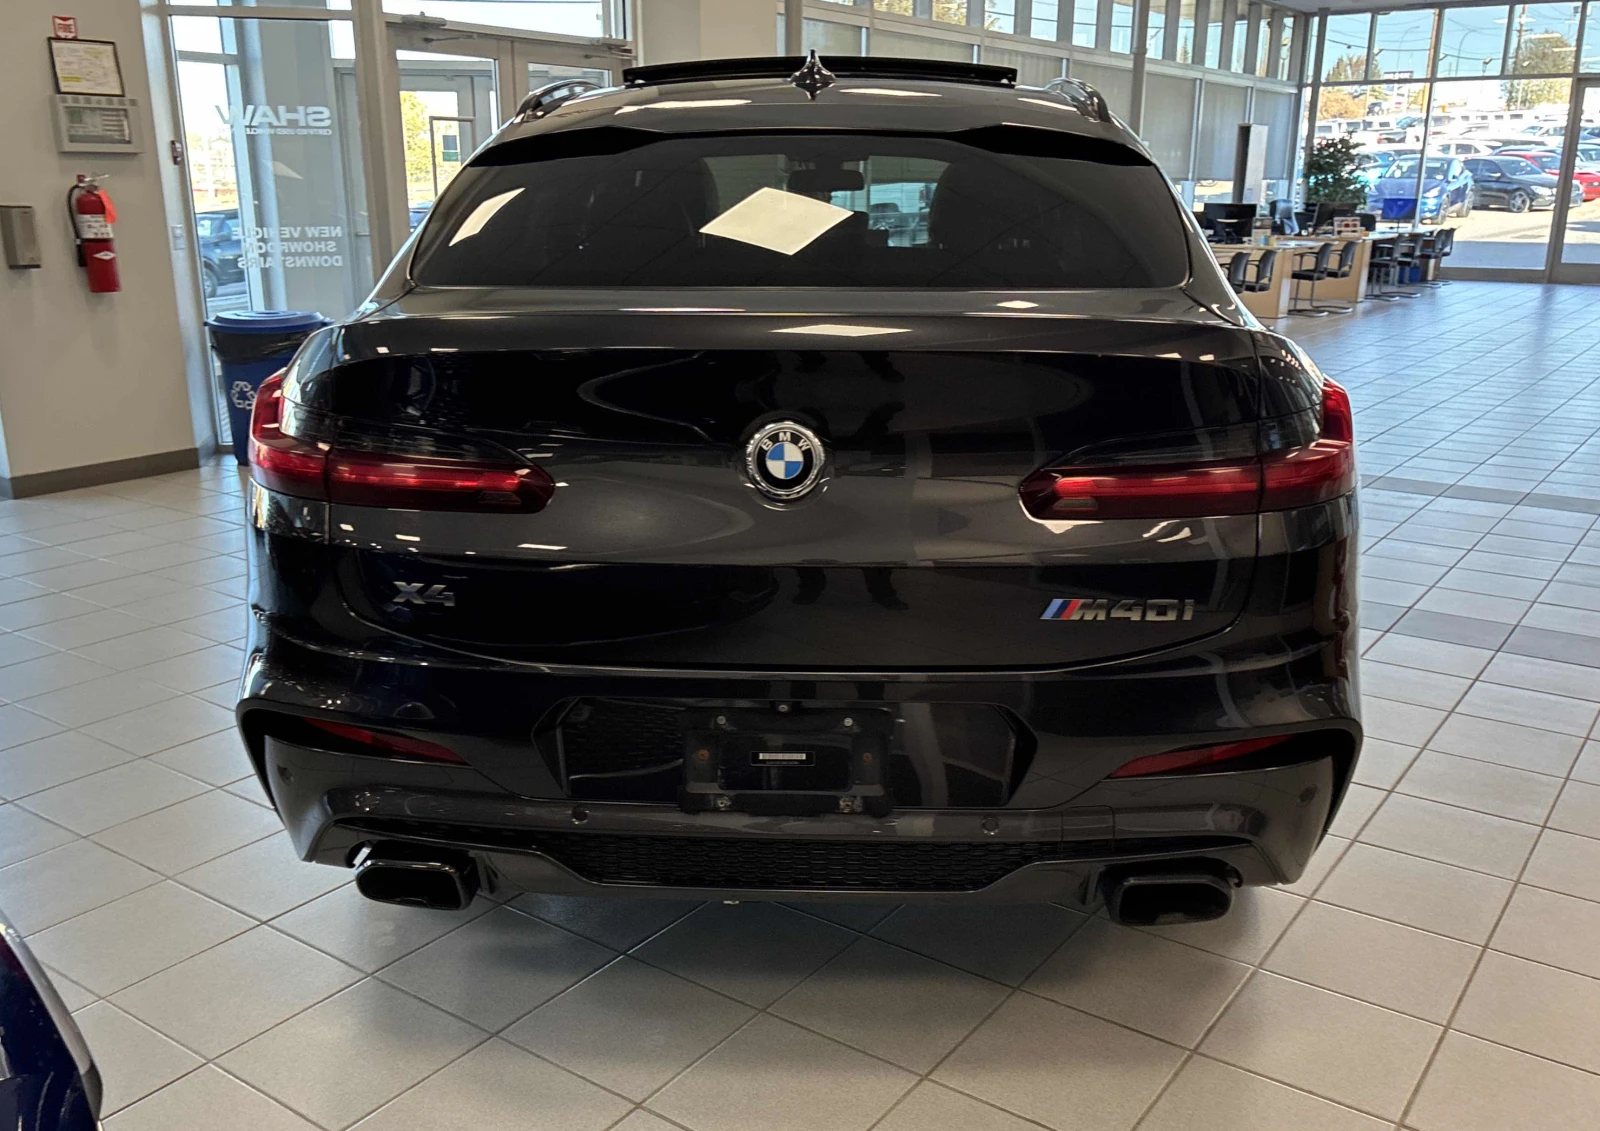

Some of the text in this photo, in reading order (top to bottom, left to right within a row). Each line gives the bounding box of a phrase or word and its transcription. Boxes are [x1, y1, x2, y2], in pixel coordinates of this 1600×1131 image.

[760, 431, 811, 451] BMW
[393, 581, 455, 606] X4
[1068, 599, 1195, 621] M40i
